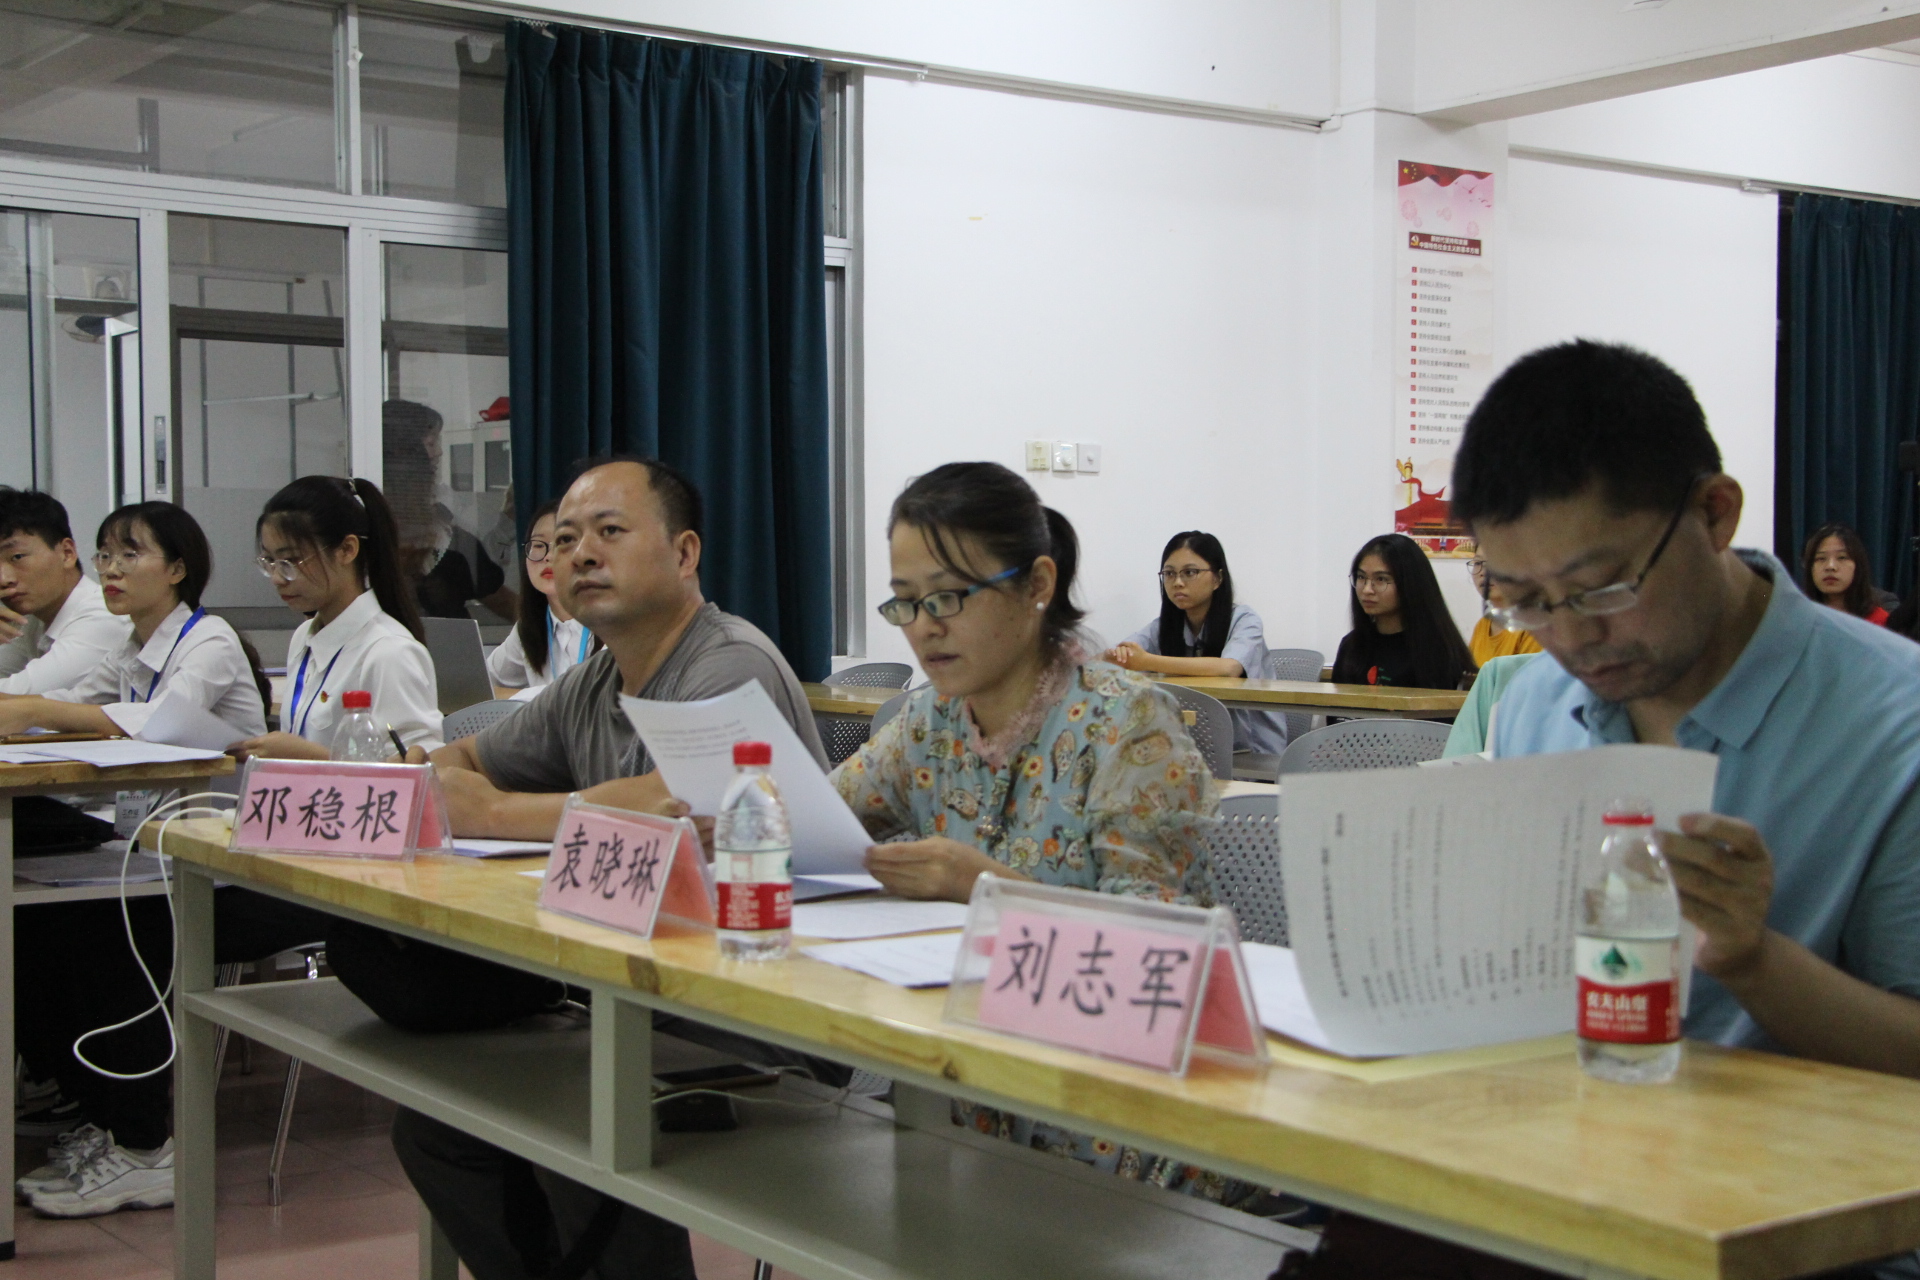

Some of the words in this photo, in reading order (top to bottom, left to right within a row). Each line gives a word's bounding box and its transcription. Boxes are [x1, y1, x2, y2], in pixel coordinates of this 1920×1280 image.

[243, 785, 401, 843] 邓稳根
[550, 823, 660, 908] 袁晓琳
[995, 925, 1190, 1034] 刘志军
